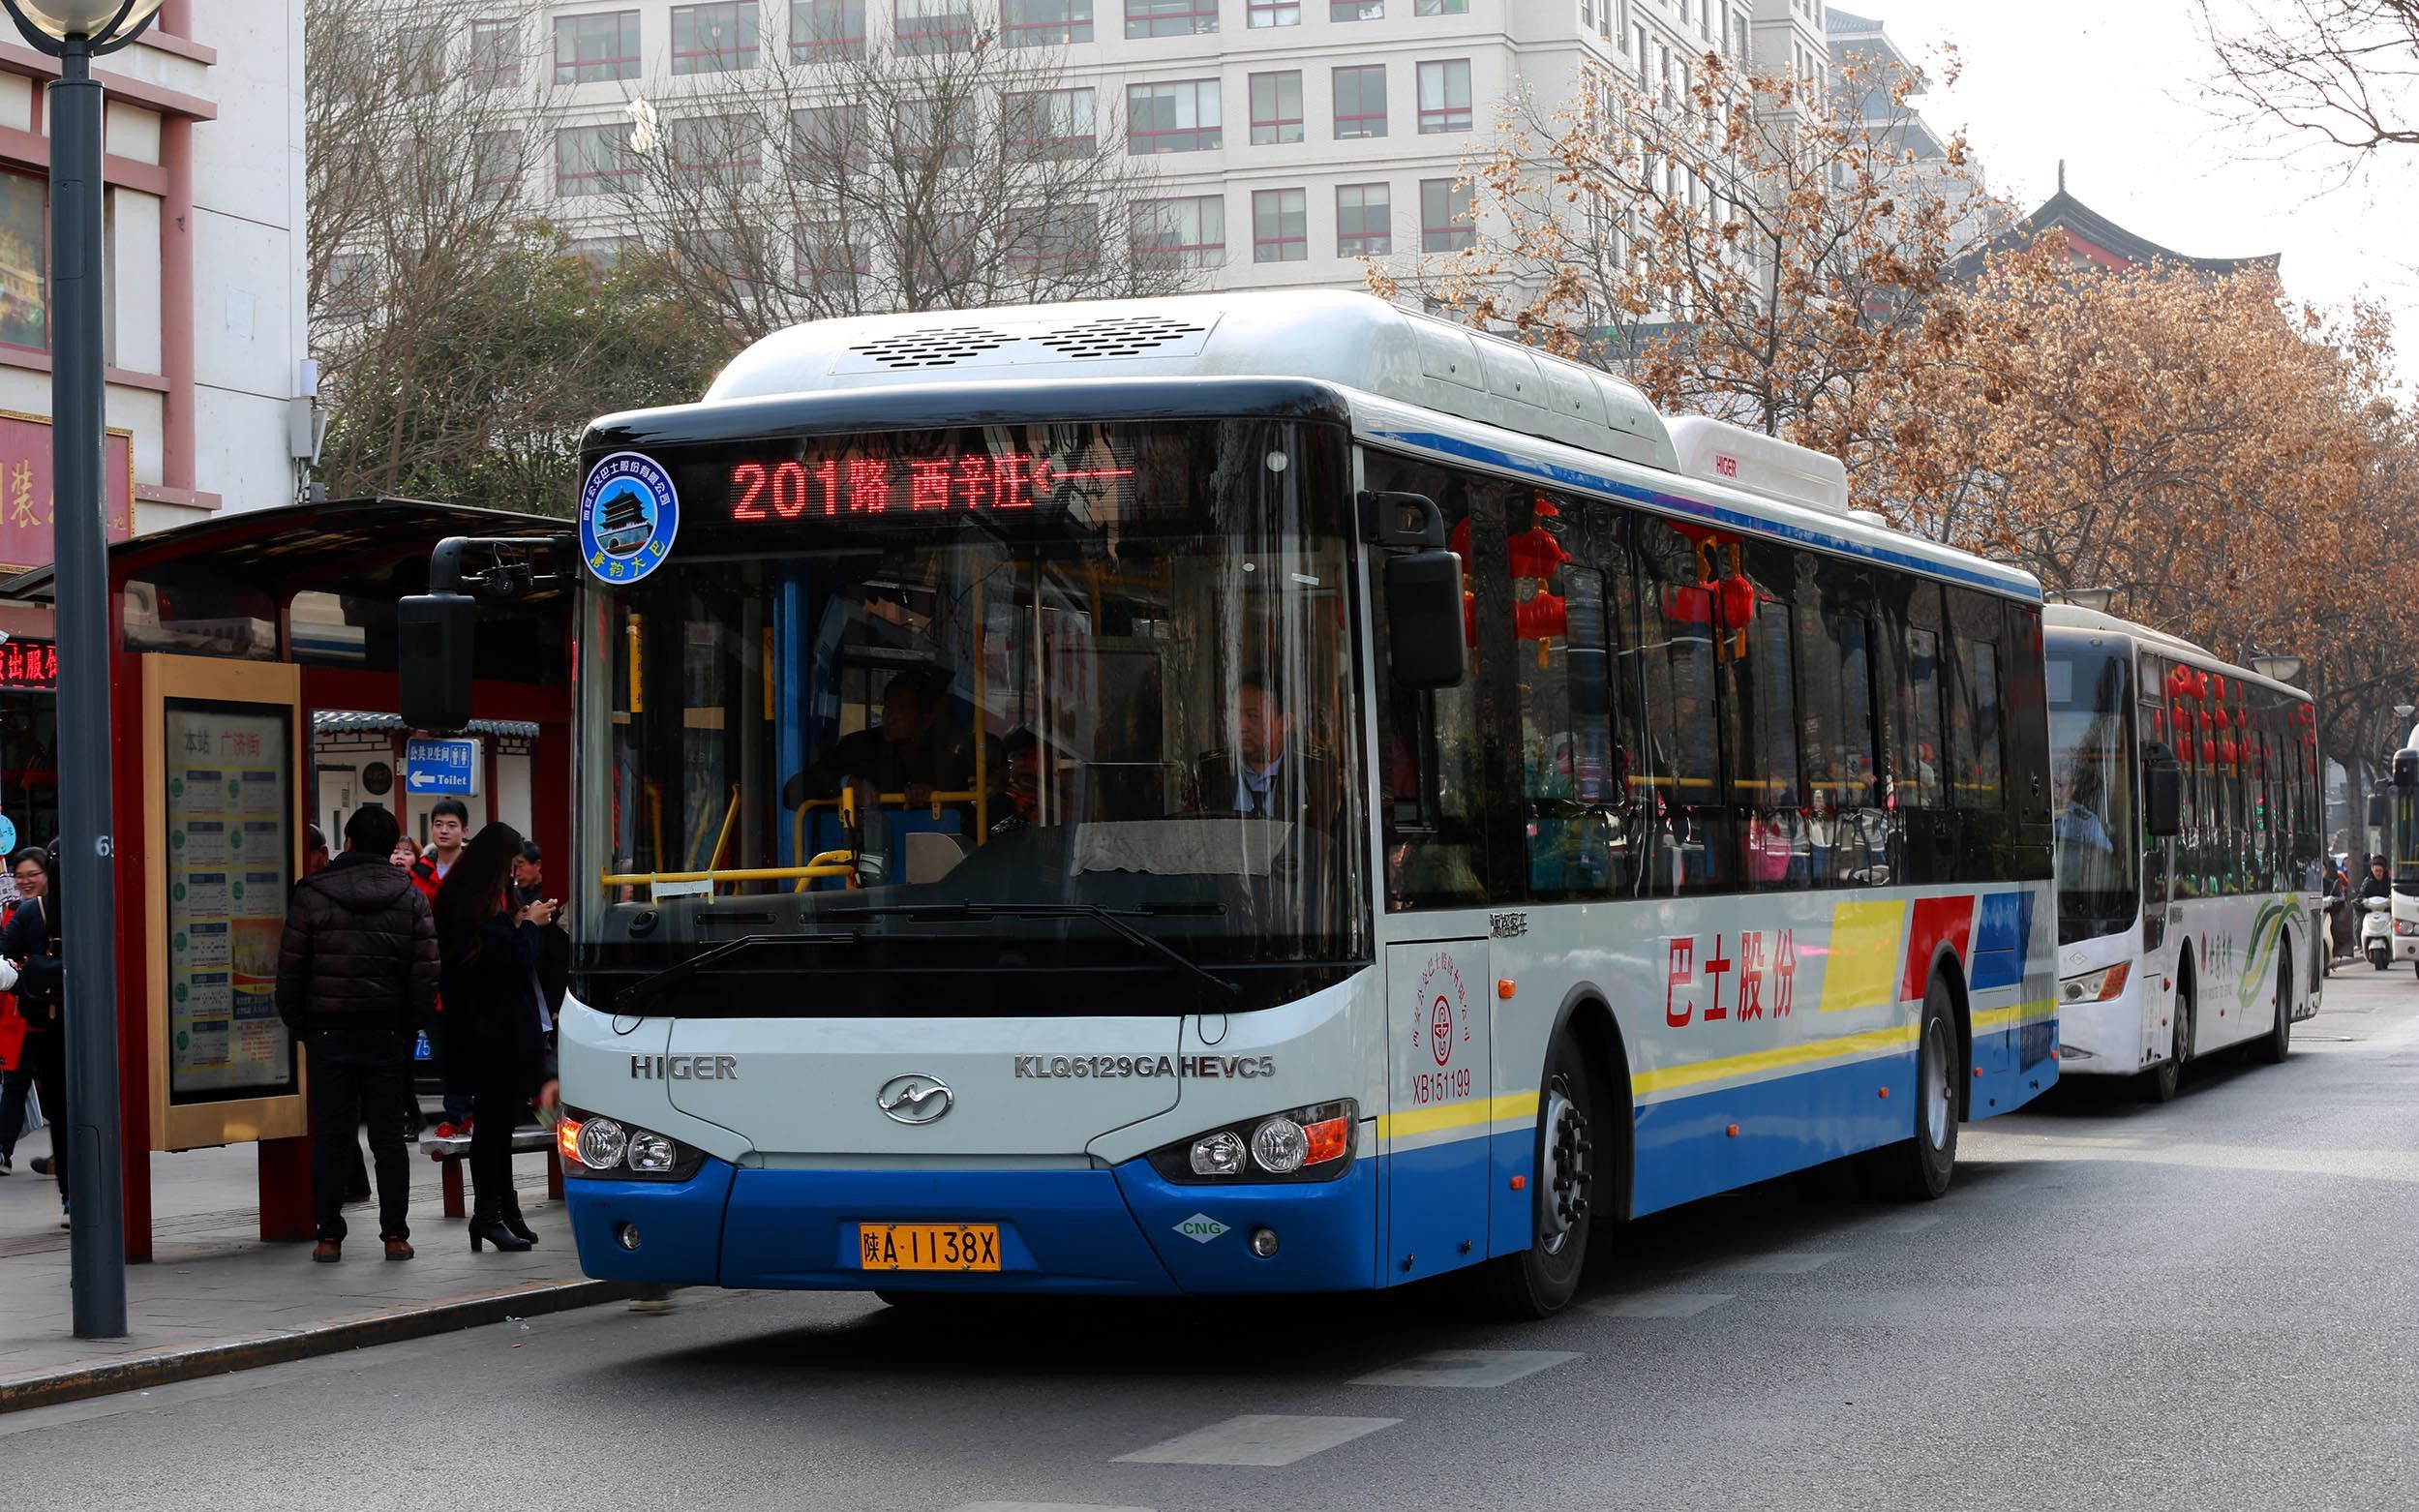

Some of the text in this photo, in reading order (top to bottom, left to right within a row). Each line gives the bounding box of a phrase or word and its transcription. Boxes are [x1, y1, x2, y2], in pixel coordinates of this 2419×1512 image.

[1715, 455, 1738, 478] HIGER
[733, 458, 889, 519] 201路
[184, 728, 210, 755] 本站
[409, 744, 450, 762] 公共卫生间
[437, 774, 467, 785] Toilet
[1666, 928, 1798, 1028] 巴士股份
[630, 1053, 739, 1079] HIGER
[1014, 1054, 1277, 1078] KLQ6129GAHEVC5
[1412, 1068, 1470, 1105] XB151199
[1182, 1222, 1223, 1235] CNG
